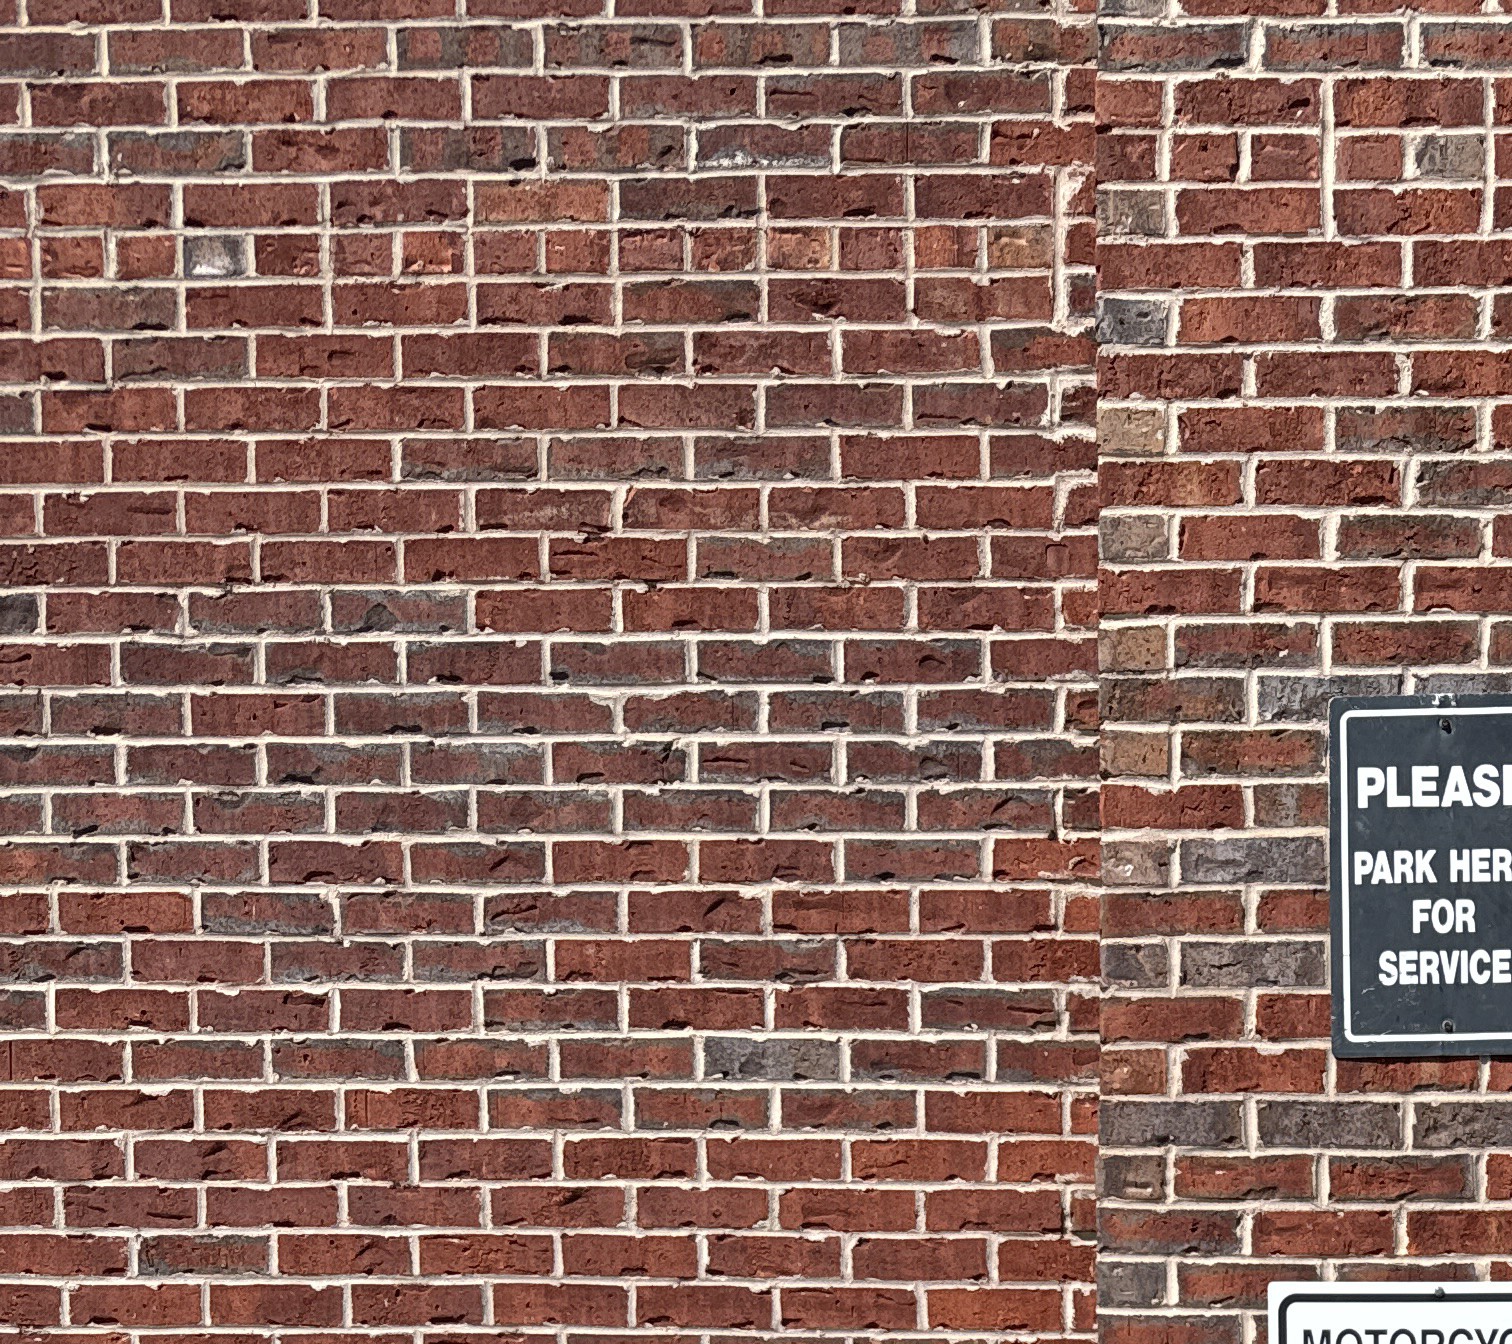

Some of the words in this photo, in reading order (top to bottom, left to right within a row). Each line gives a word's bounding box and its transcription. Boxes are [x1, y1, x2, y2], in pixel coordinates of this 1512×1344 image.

[1354, 850, 1437, 885] PARK
[1412, 899, 1476, 933] FOR
[1378, 949, 1512, 985] SERVICE
